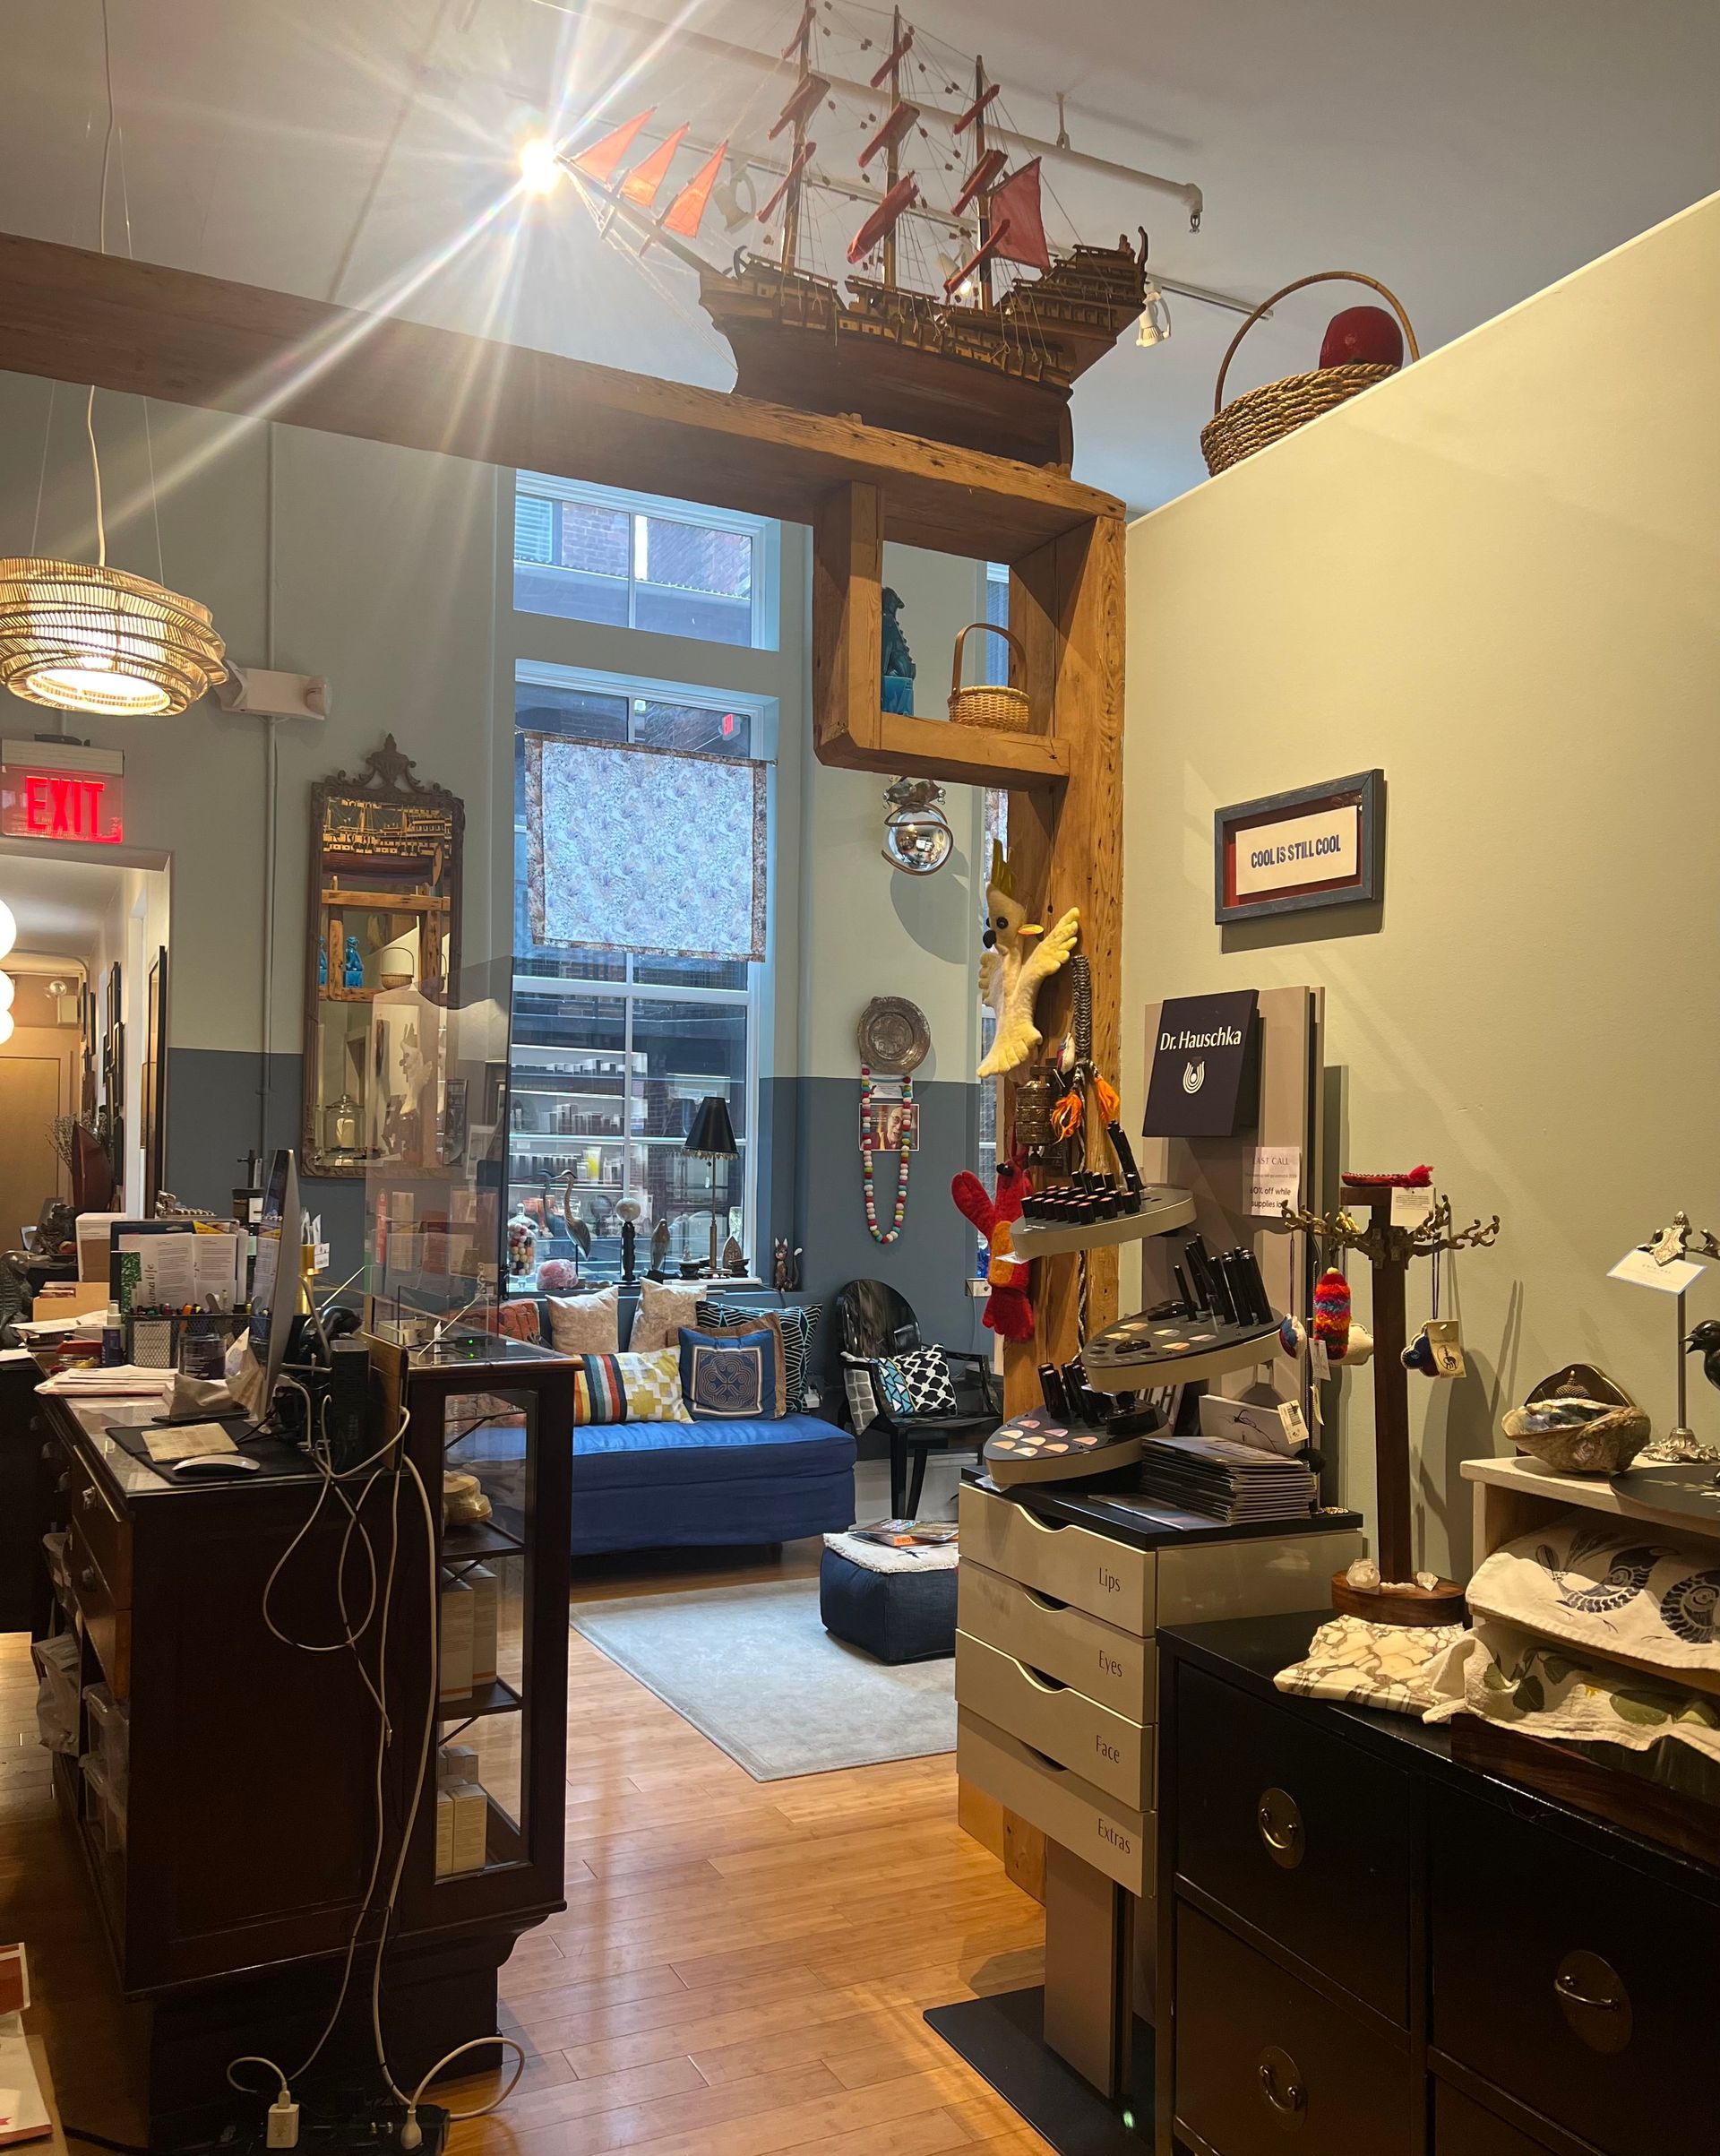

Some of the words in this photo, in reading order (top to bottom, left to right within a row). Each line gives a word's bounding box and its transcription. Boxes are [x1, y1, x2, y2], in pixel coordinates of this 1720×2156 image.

[25, 775, 105, 836] EXIT
[1251, 849, 1276, 869] COOL
[1277, 846, 1286, 865] IS
[1287, 841, 1315, 861] STILL
[1315, 834, 1341, 856] COOL
[1160, 1032, 1177, 1051] Dr.
[1178, 1026, 1243, 1049] Hauschka
[1272, 1157, 1290, 1165] CALL
[1264, 1186, 1274, 1194] off
[1275, 1187, 1292, 1195] while
[1251, 1200, 1276, 1209] supplies
[1099, 1567, 1121, 1592] Lips
[1099, 1650, 1122, 1677] Eyes
[1096, 1735, 1120, 1764] Face
[1098, 1818, 1131, 1854] Extras
